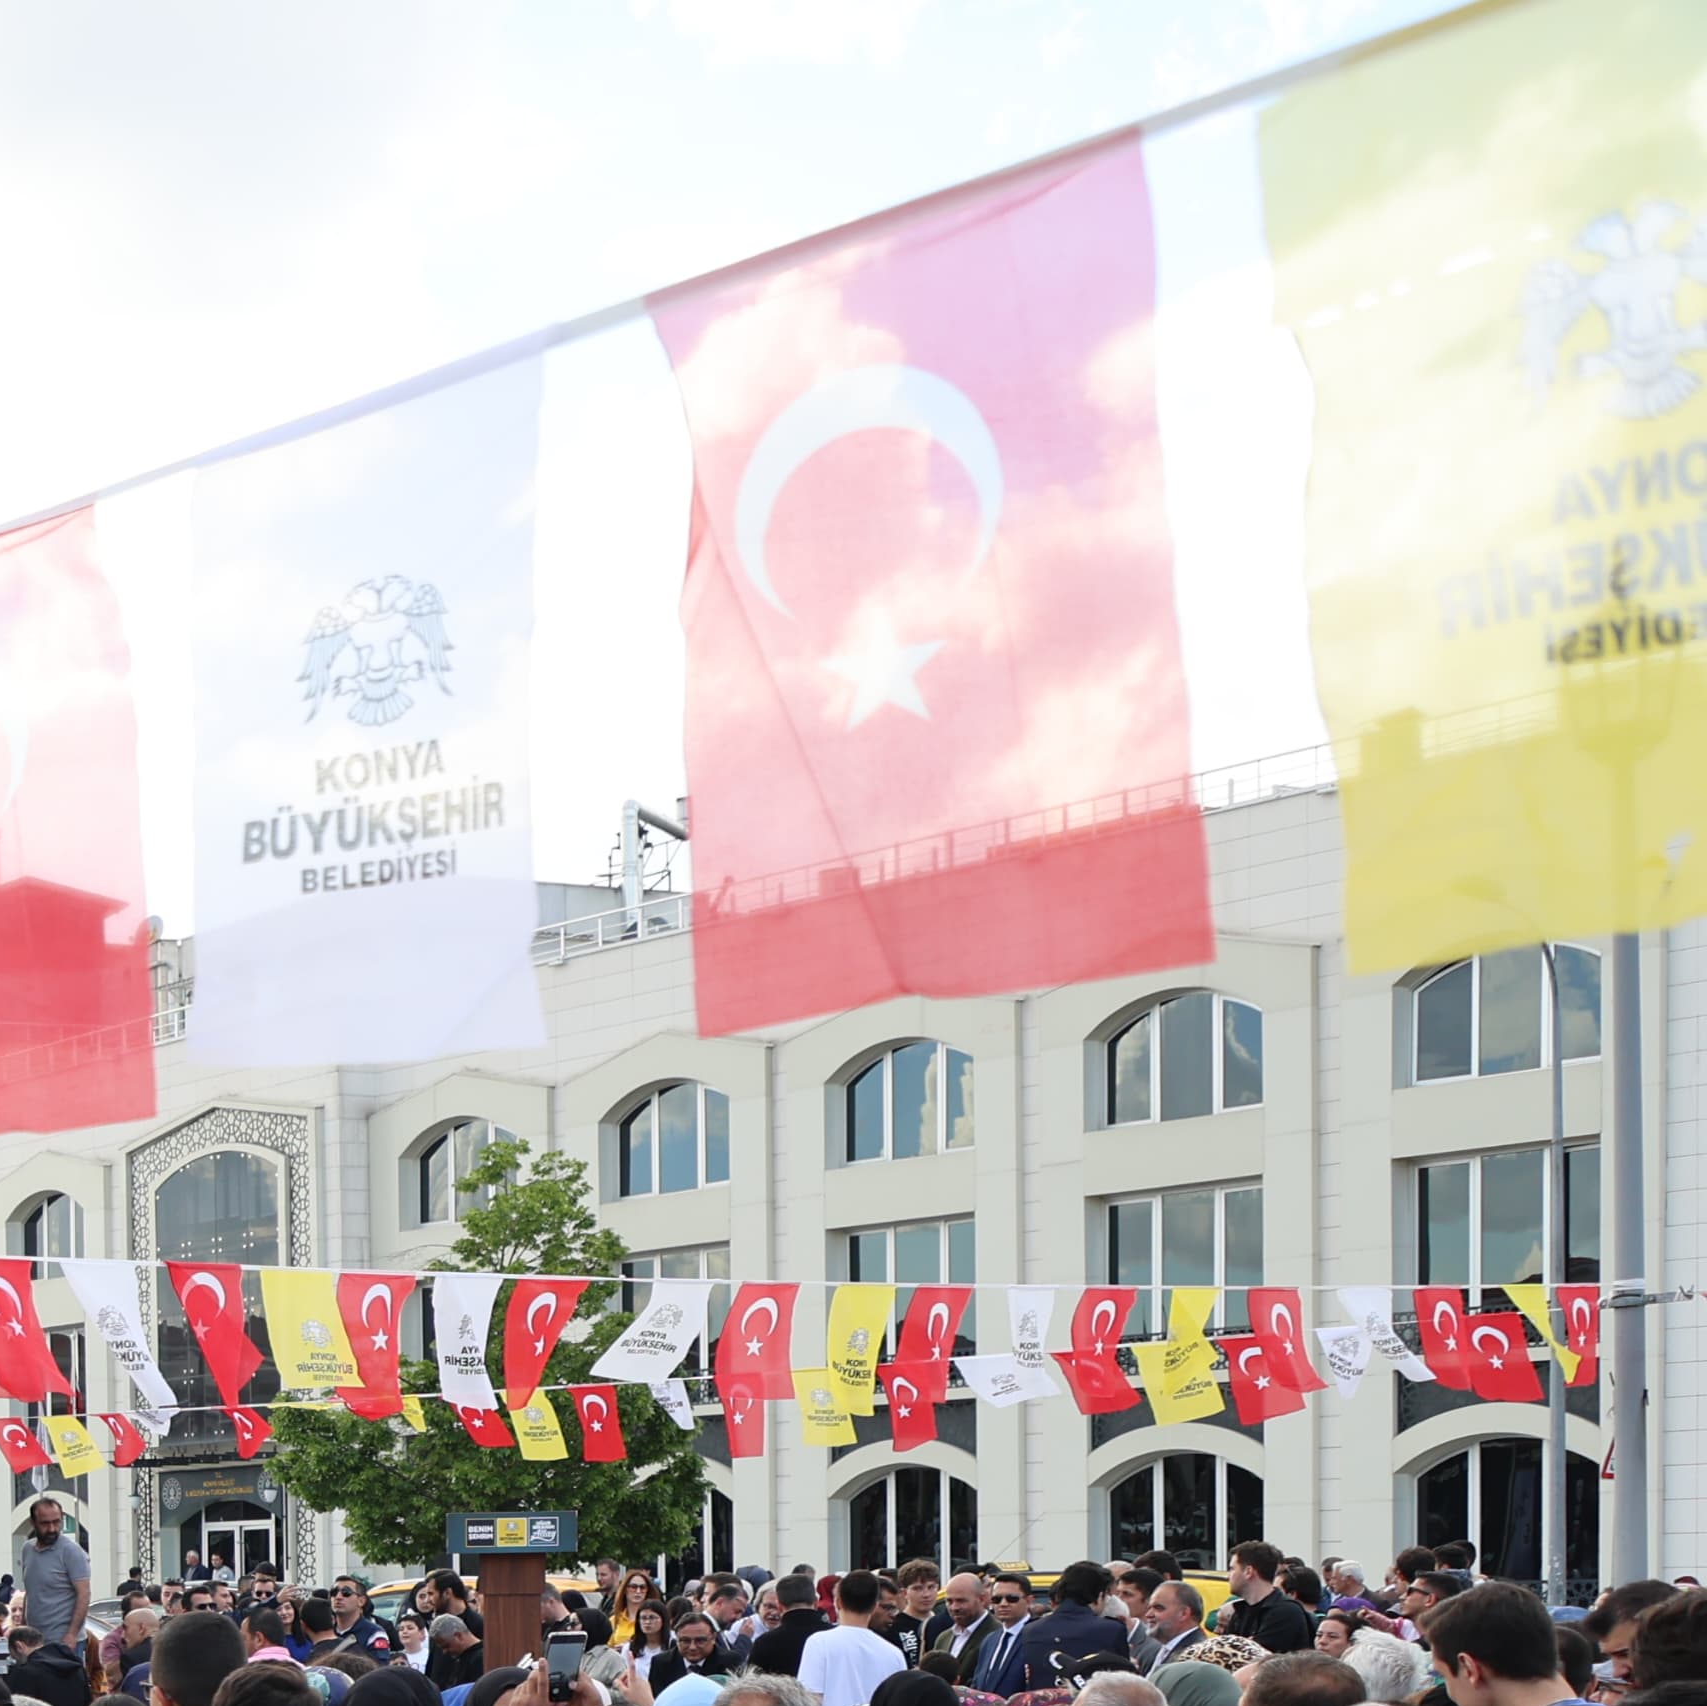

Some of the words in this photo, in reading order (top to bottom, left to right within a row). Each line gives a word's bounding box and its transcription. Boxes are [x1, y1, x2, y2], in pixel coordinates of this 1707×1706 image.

[315, 739, 444, 794] KONYA
[242, 776, 504, 865] BÜYÜKŞEHİR
[301, 842, 457, 893] BELEDİYESİ
[621, 1338, 677, 1353] BÜYÜKŞEHİR
[640, 1331, 666, 1339] KONYA
